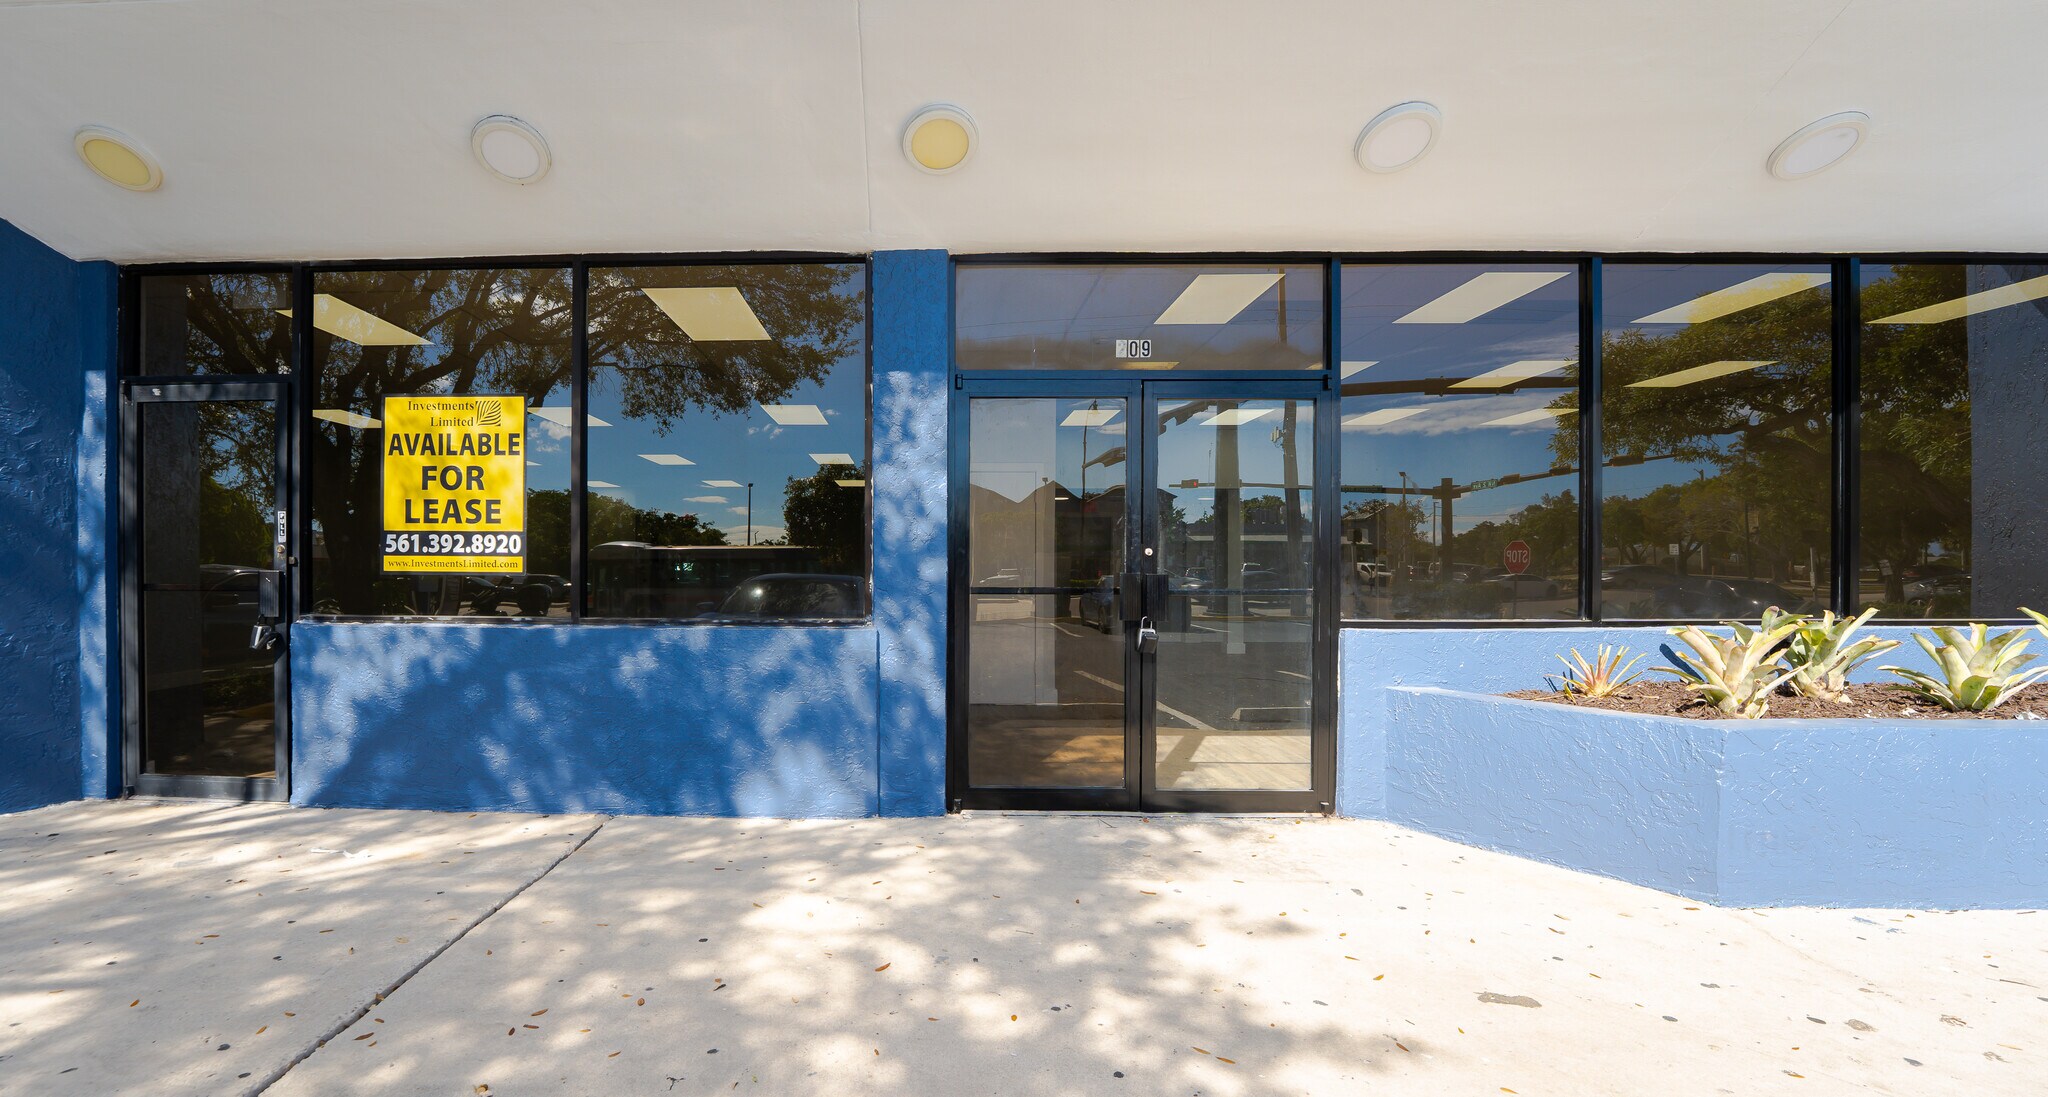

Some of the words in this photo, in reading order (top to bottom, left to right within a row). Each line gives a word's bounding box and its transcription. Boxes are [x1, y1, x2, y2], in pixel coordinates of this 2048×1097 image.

[408, 401, 475, 411] Investments
[430, 417, 474, 427] Limited
[388, 433, 521, 456] AVAILABLE
[422, 465, 485, 491] FOR
[404, 499, 502, 524] LEASE
[385, 533, 521, 554] 561.392.8920
[387, 558, 519, 569] www.InvestmentsLimited.com
